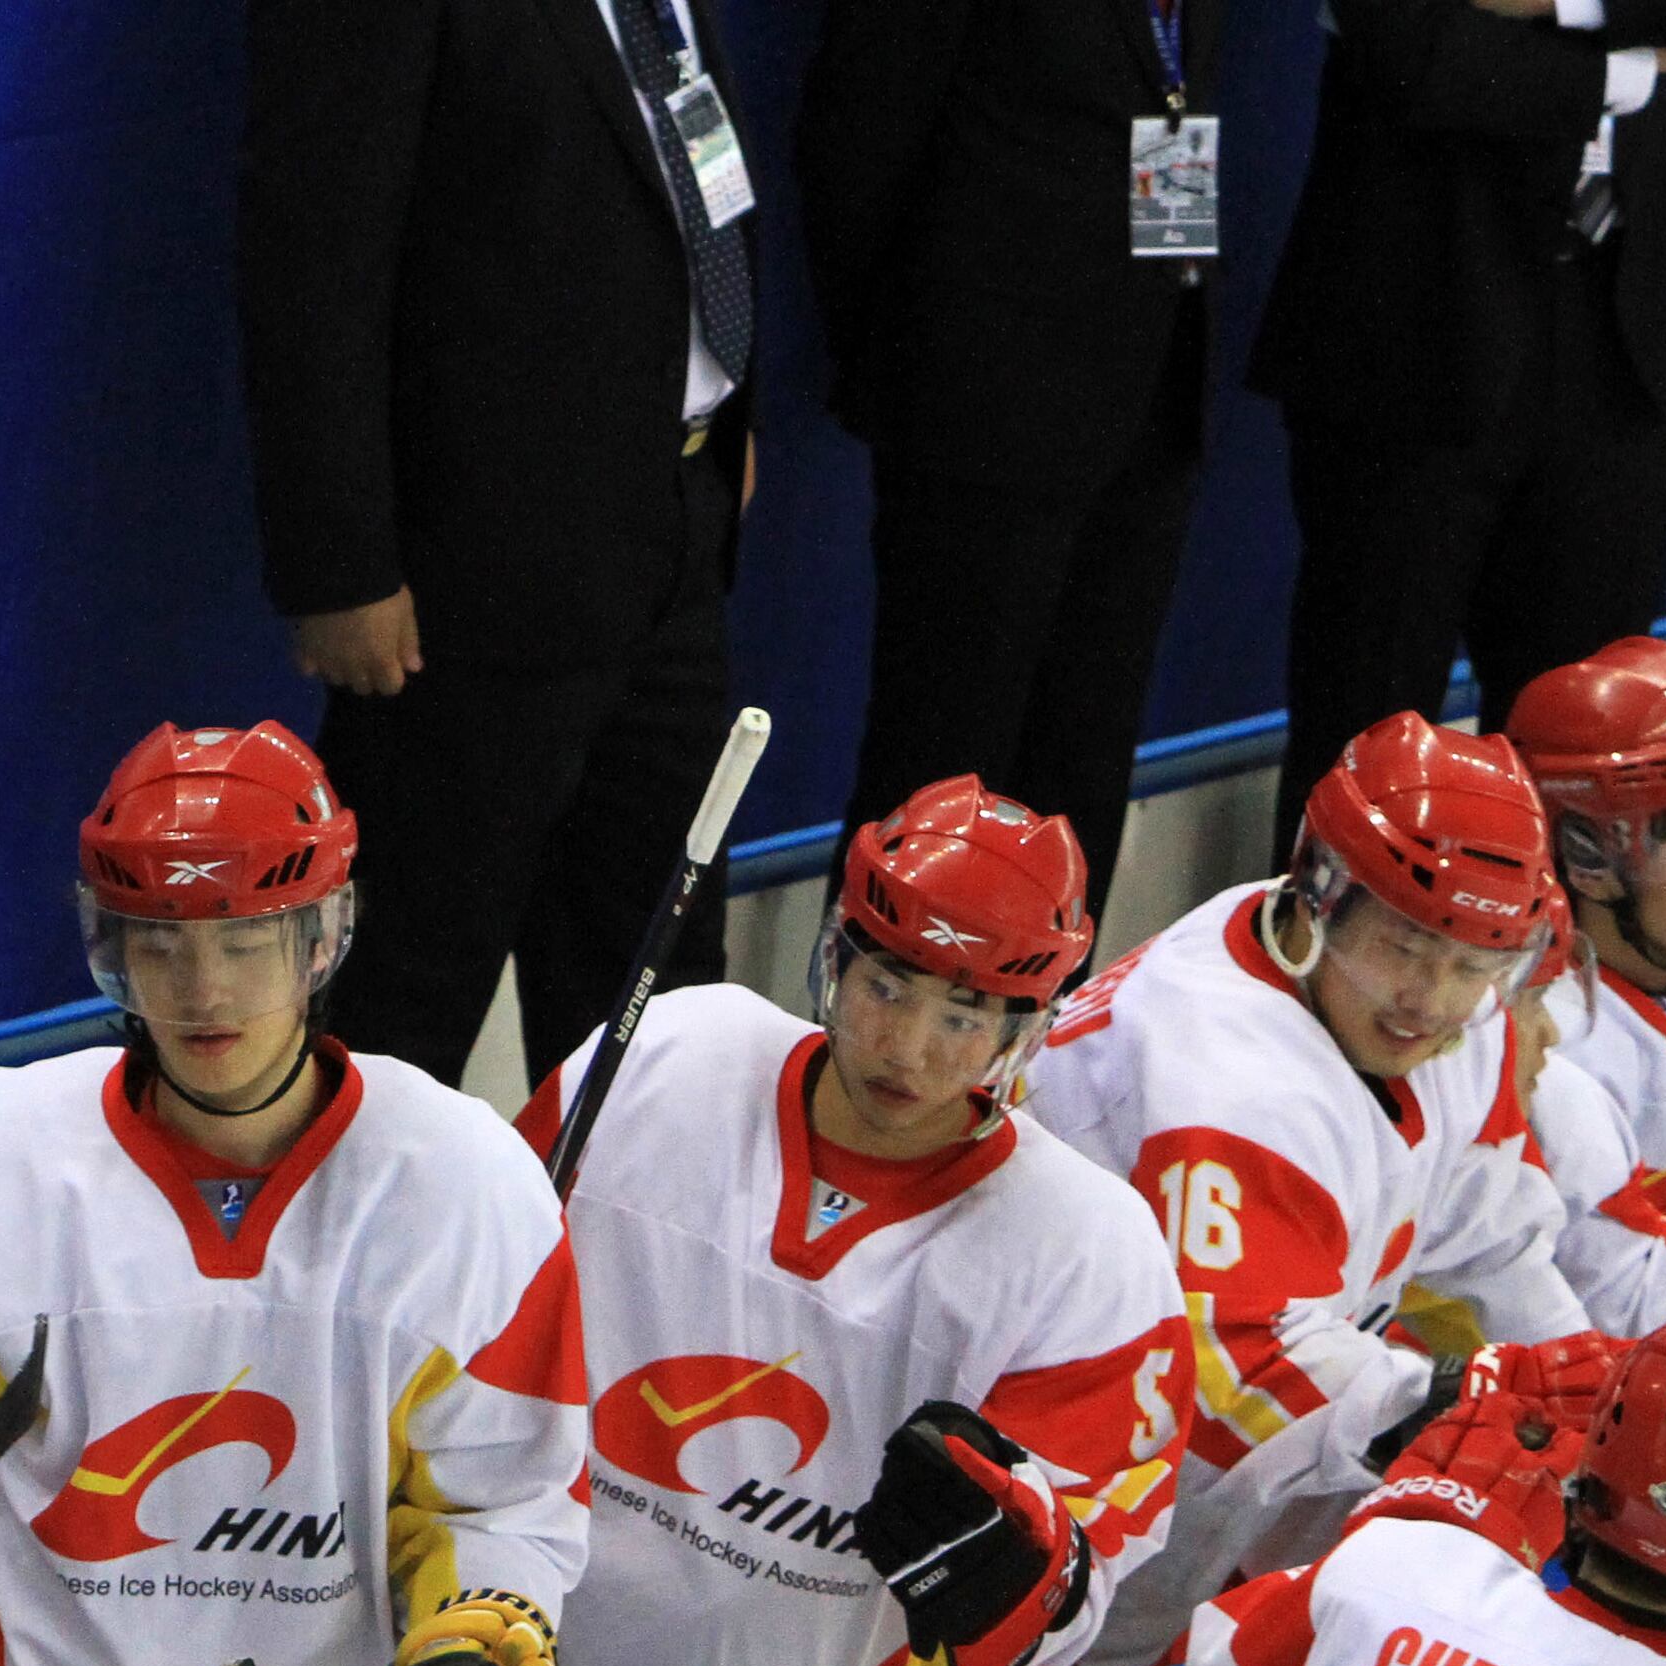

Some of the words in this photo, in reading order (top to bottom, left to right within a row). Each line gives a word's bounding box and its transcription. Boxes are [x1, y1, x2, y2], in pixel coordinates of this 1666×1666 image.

[1451, 890, 1522, 916] CCM
[1159, 1158, 1244, 1271] 16
[1129, 1348, 1180, 1462] 5
[651, 1501, 677, 1532] Ice
[681, 1520, 761, 1578] Hockey
[119, 1574, 156, 1598] Ice
[164, 1574, 255, 1602] Hockey
